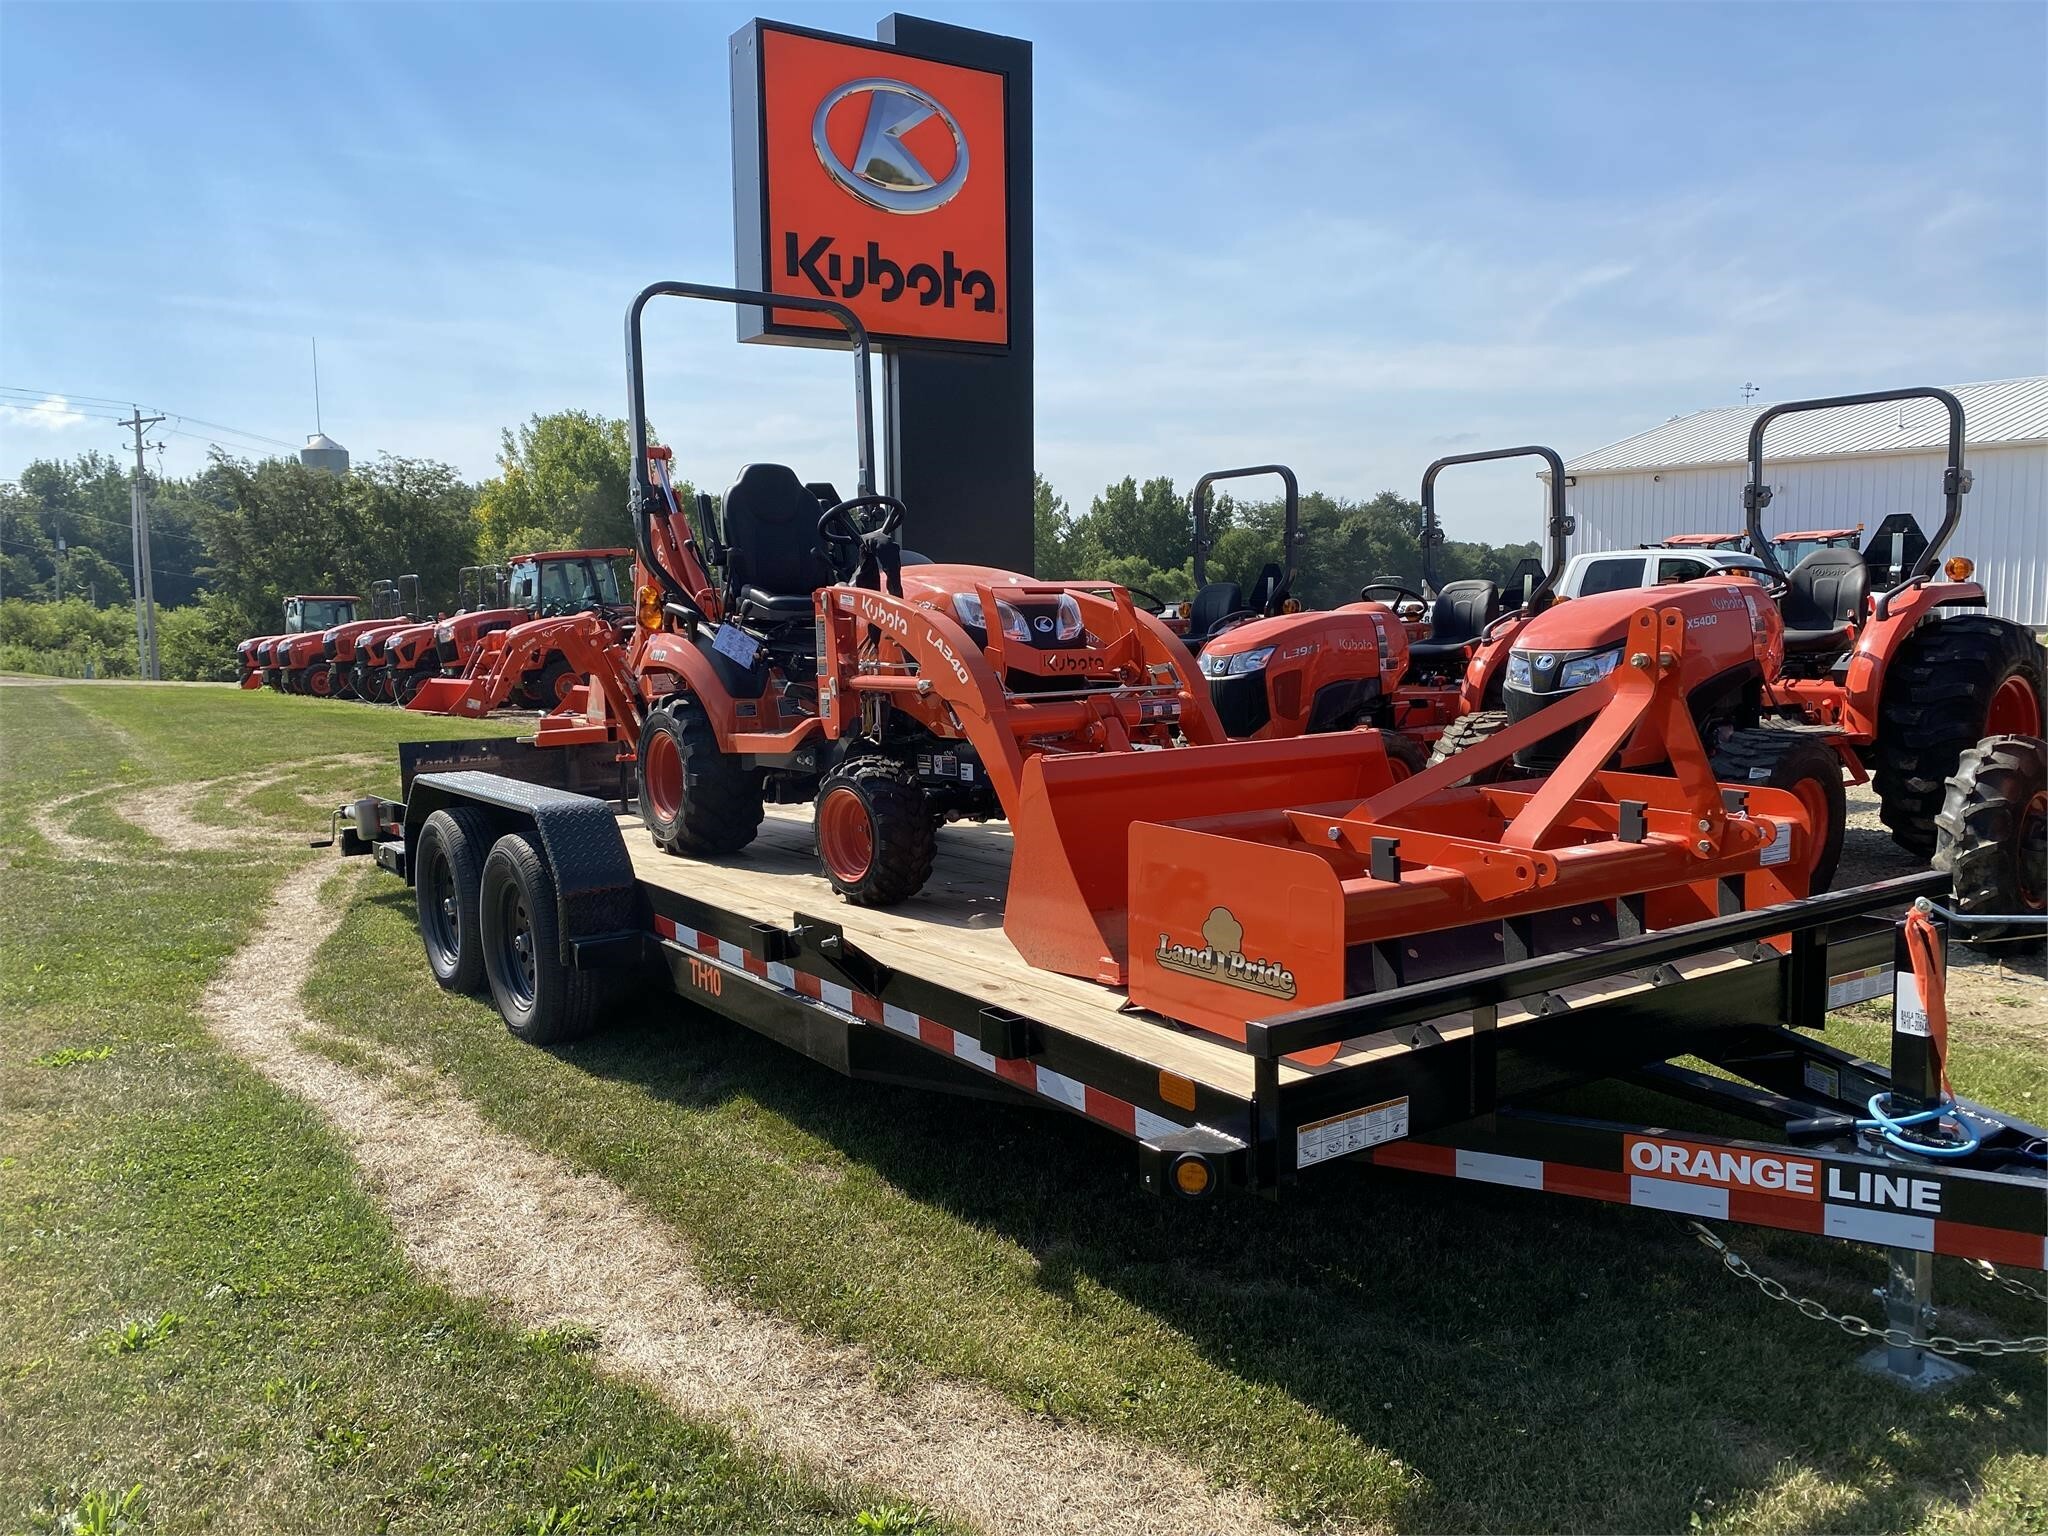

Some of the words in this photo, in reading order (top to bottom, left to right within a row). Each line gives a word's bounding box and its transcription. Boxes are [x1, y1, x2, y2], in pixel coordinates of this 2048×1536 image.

[785, 232, 995, 313] Kubota
[861, 595, 908, 636] Kubota
[1686, 614, 1718, 630] X5400
[1711, 597, 1745, 610] Kubota
[926, 629, 970, 685] LA340
[1043, 654, 1104, 671] Kubota
[1338, 639, 1373, 651] Kubota
[688, 957, 721, 997] TH10
[1157, 934, 1213, 971] Land
[1227, 951, 1294, 991] Pride
[1630, 1142, 1814, 1194] ORANGE
[1828, 1167, 1942, 1213] LINE
